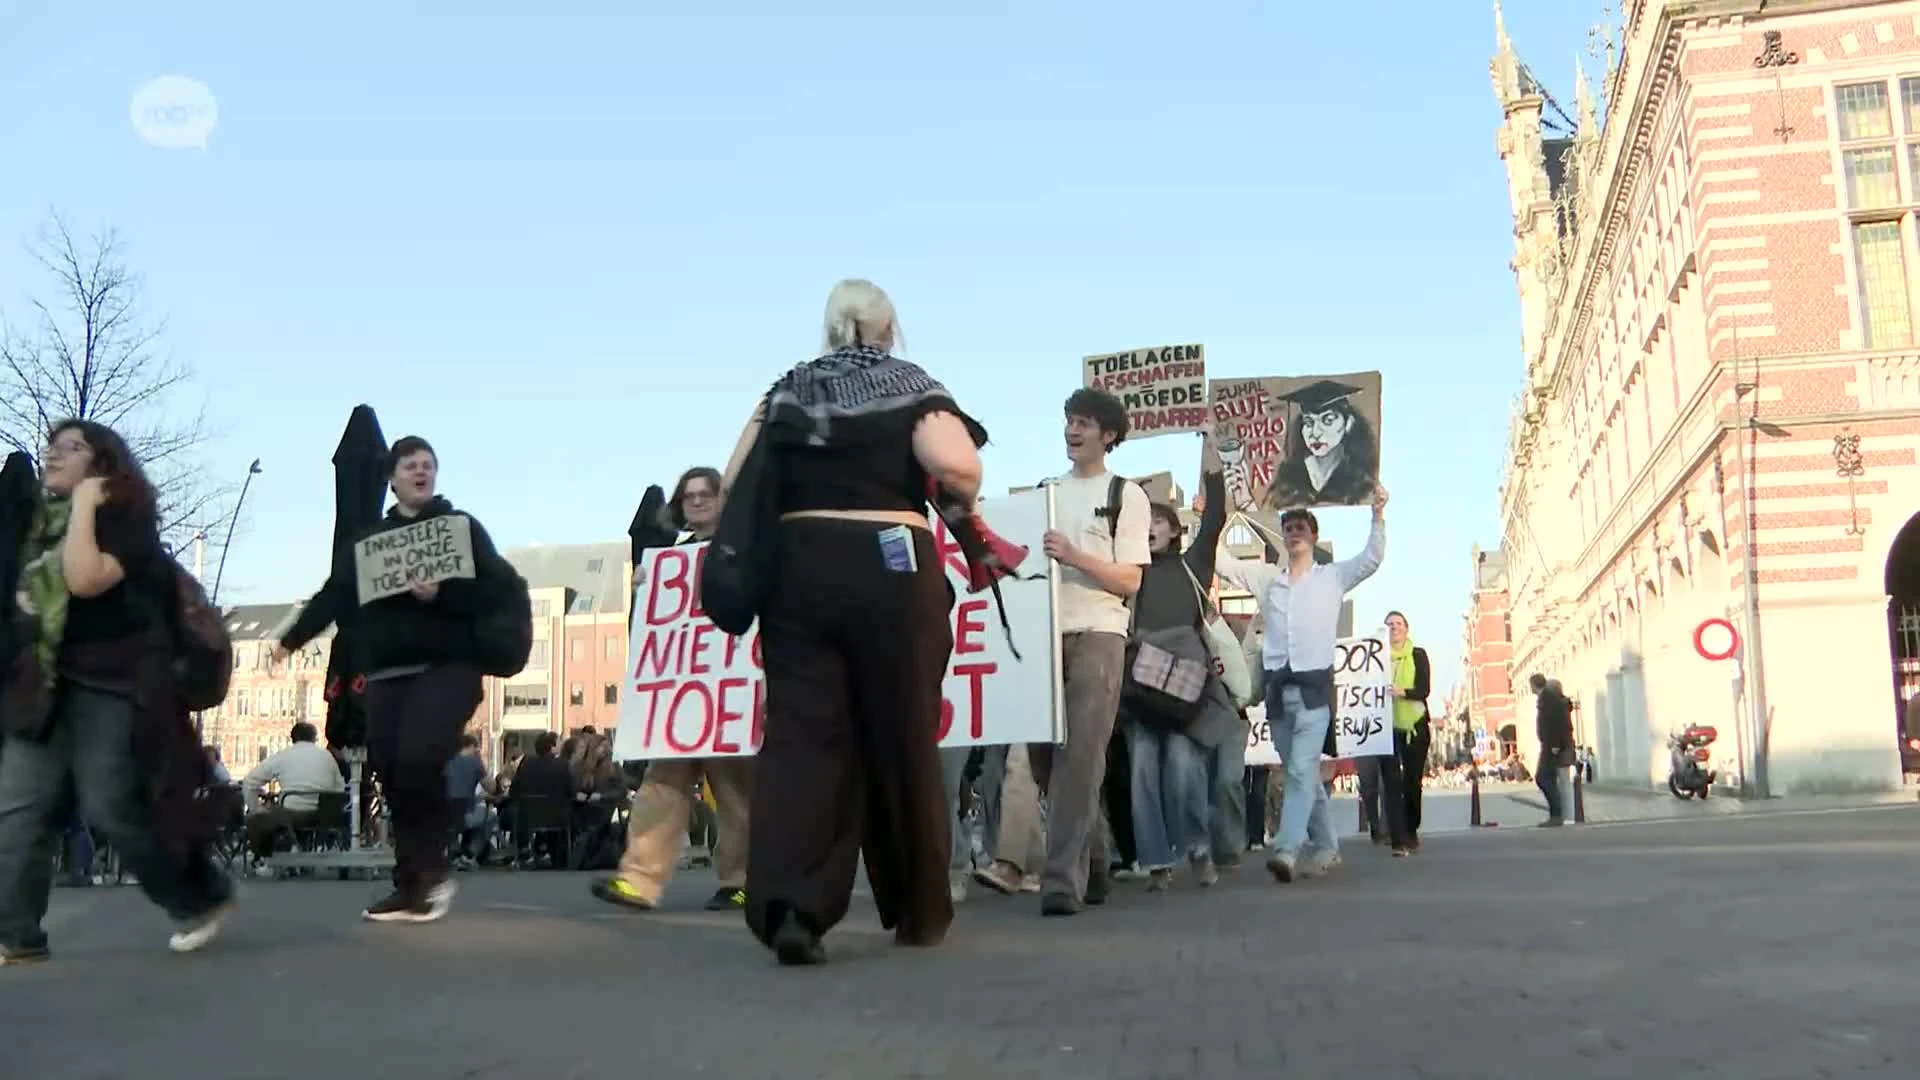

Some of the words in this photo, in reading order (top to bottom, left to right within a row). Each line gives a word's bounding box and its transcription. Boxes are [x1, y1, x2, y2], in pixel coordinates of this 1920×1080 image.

[1088, 344, 1200, 376] TOELAGEN
[1091, 361, 1205, 391] AFSCHAFFEN
[1216, 380, 1265, 401] ZUHAL
[1236, 416, 1286, 440] DIPLO
[1248, 438, 1280, 460] MA
[365, 518, 451, 556] INVESTEER
[384, 554, 403, 569] IN
[406, 536, 457, 566] ONZE
[371, 555, 463, 593] TOEKOMST
